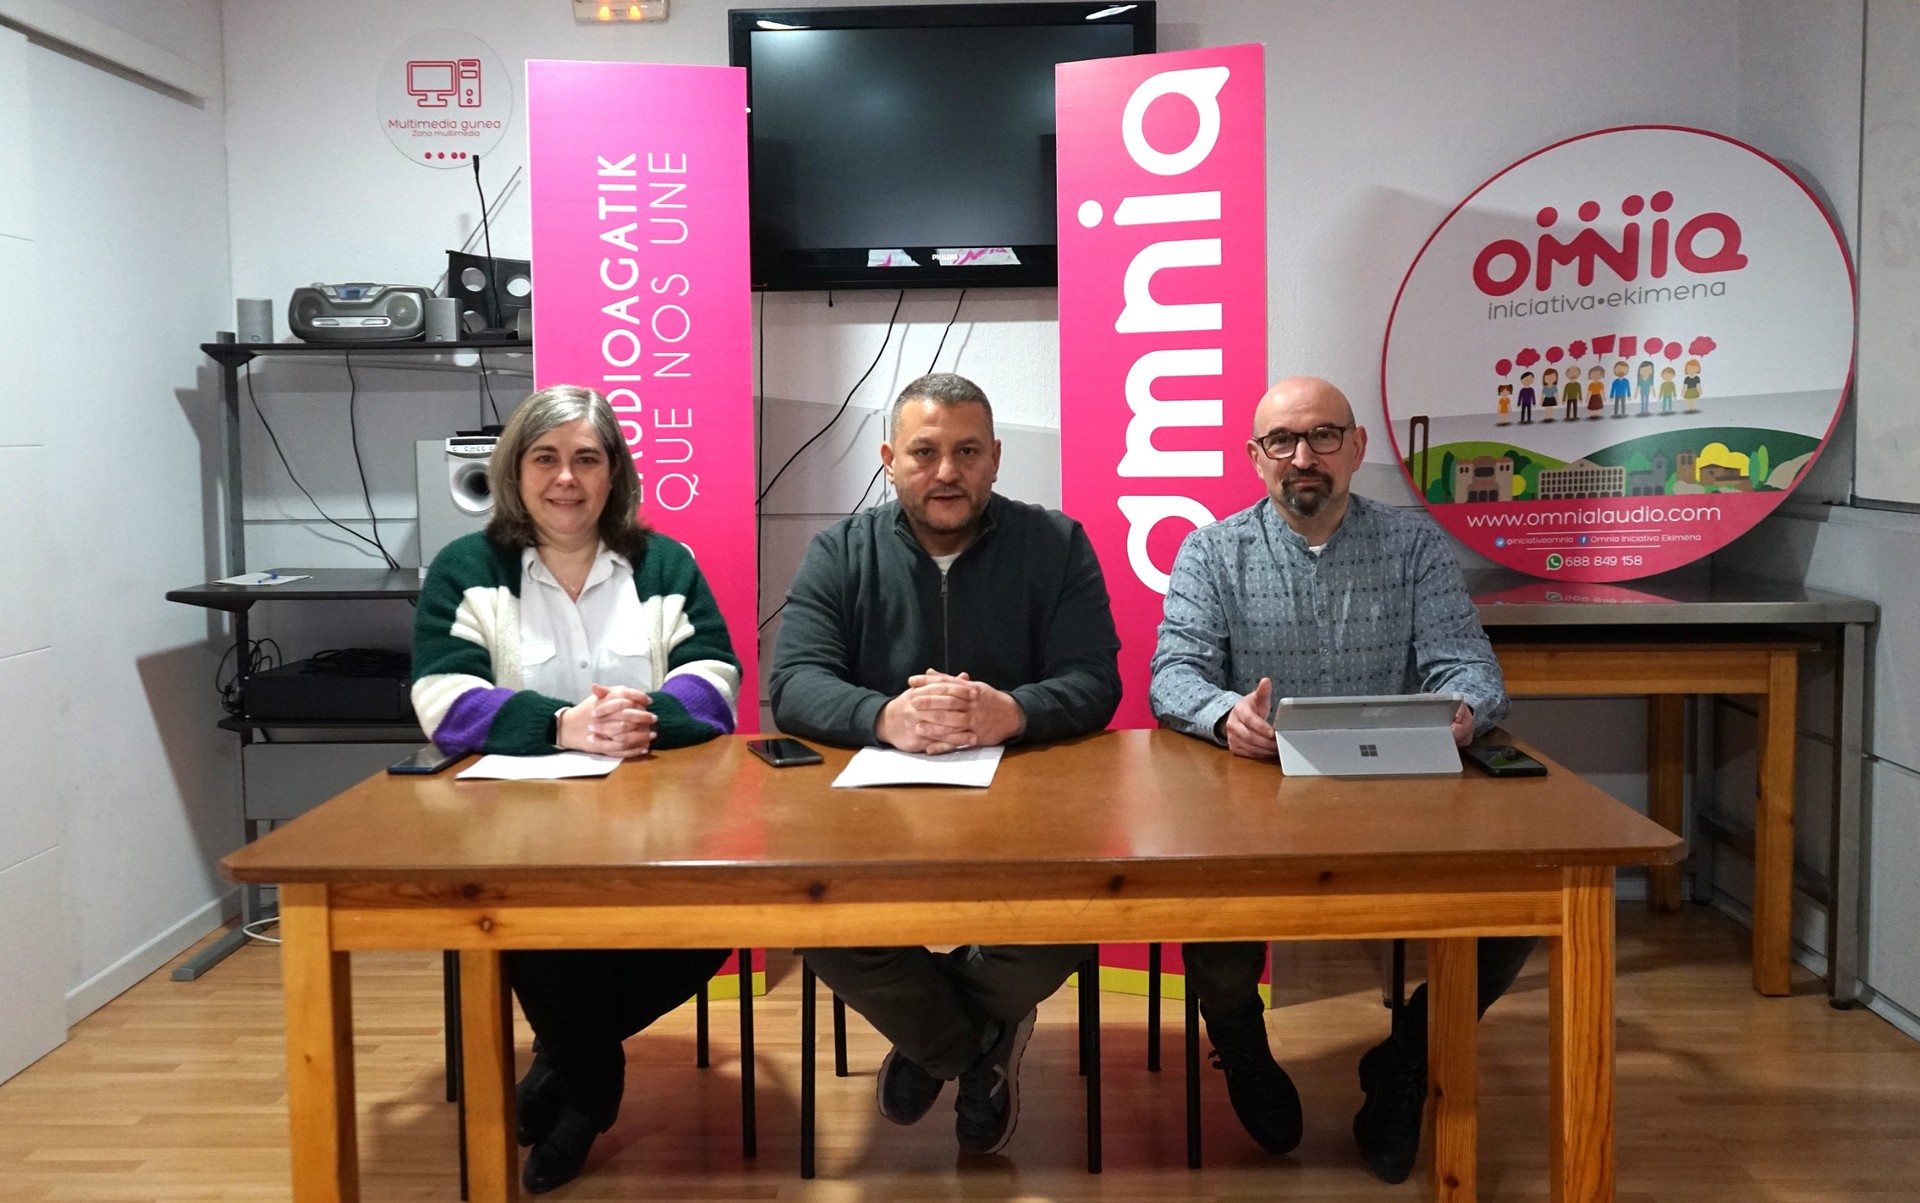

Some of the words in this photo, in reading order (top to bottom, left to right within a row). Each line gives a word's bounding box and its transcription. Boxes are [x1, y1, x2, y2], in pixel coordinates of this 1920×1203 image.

[388, 118, 457, 129] Multimedia
[460, 119, 501, 130] gunea
[411, 129, 432, 137] Zona
[648, 152, 689, 244] UNE
[651, 273, 692, 377] NOS
[654, 408, 699, 511] QUE
[1467, 506, 1721, 527] www.omnialaudio.com
[1591, 536, 1620, 544] Omnia
[1621, 534, 1659, 543] Iniciativa
[1661, 533, 1701, 542] Ekimena
[1565, 556, 1590, 567] 688
[1594, 556, 1617, 566] 849
[1622, 555, 1643, 566] 158
